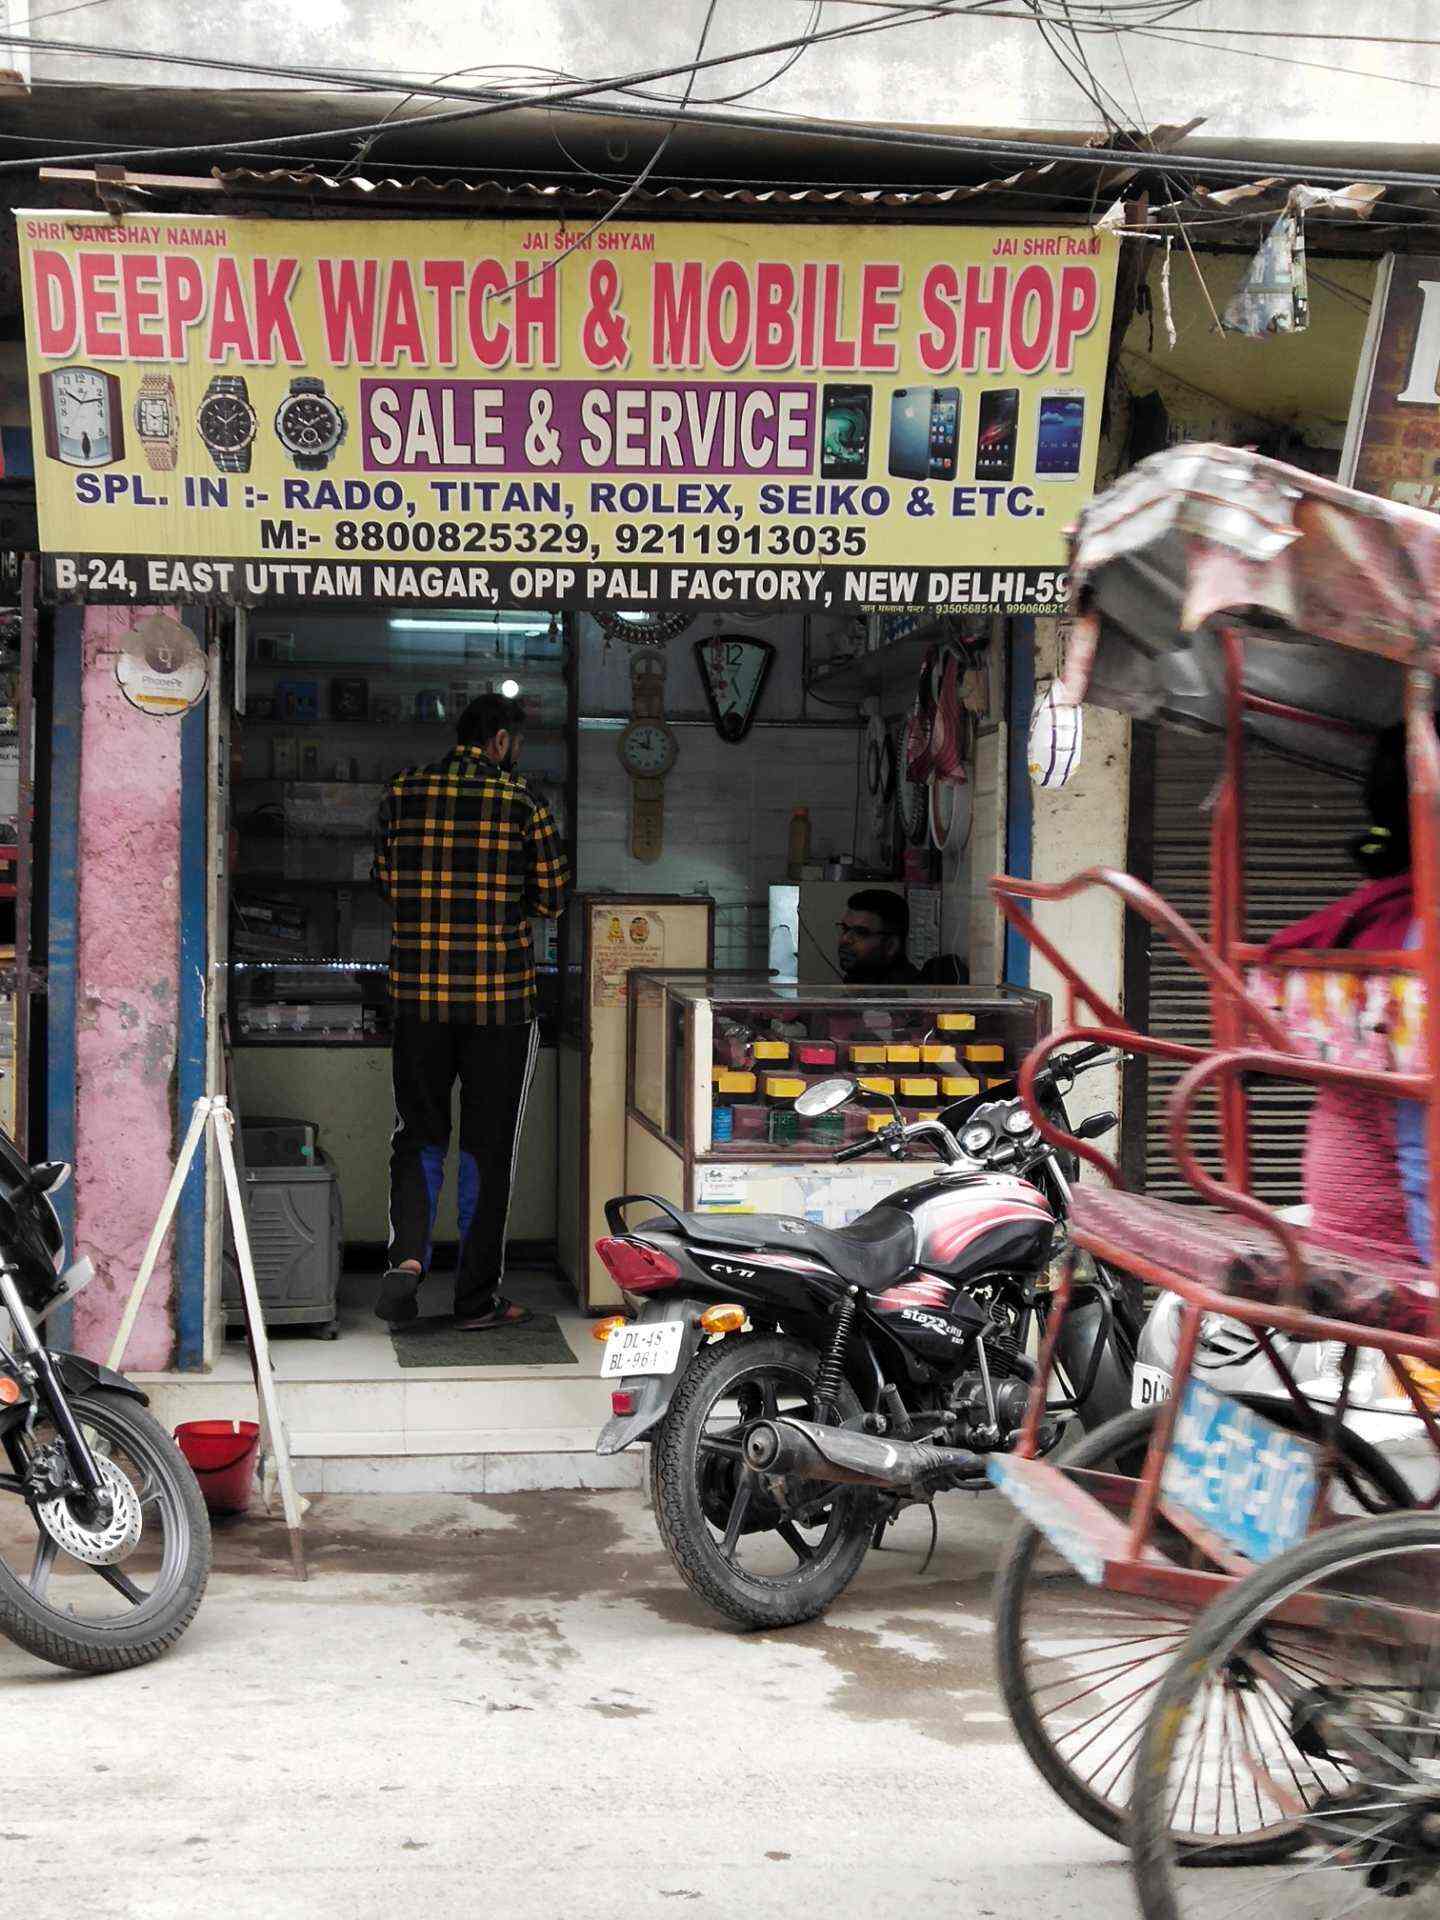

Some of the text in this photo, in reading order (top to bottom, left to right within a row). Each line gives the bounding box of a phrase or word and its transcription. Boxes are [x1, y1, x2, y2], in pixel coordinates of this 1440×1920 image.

[27, 222, 227, 247] SHRI GANESHAY NAMAH
[523, 232, 655, 251] JAI SHRI SHYAM
[992, 238, 1101, 256] JAI SHRI RAM
[31, 249, 1098, 370] DEEPAK WATCH & MOBILE SHOP
[369, 387, 809, 468] SALE & SERVICE
[76, 472, 168, 506] SPL.
[184, 476, 228, 508] IN
[285, 479, 415, 518] RADO,
[430, 481, 574, 519] TITAN,
[590, 482, 743, 521] ROLEX,
[759, 484, 890, 516] SEIKO
[906, 487, 934, 517] &
[951, 487, 1045, 517] ETC.
[261, 519, 867, 560] M:- 8800825329, 9211913035
[56, 559, 1072, 607] B-24, EAST UTTAM NAGAR, OPP PALI FACTORY, NEW DELHI-59
